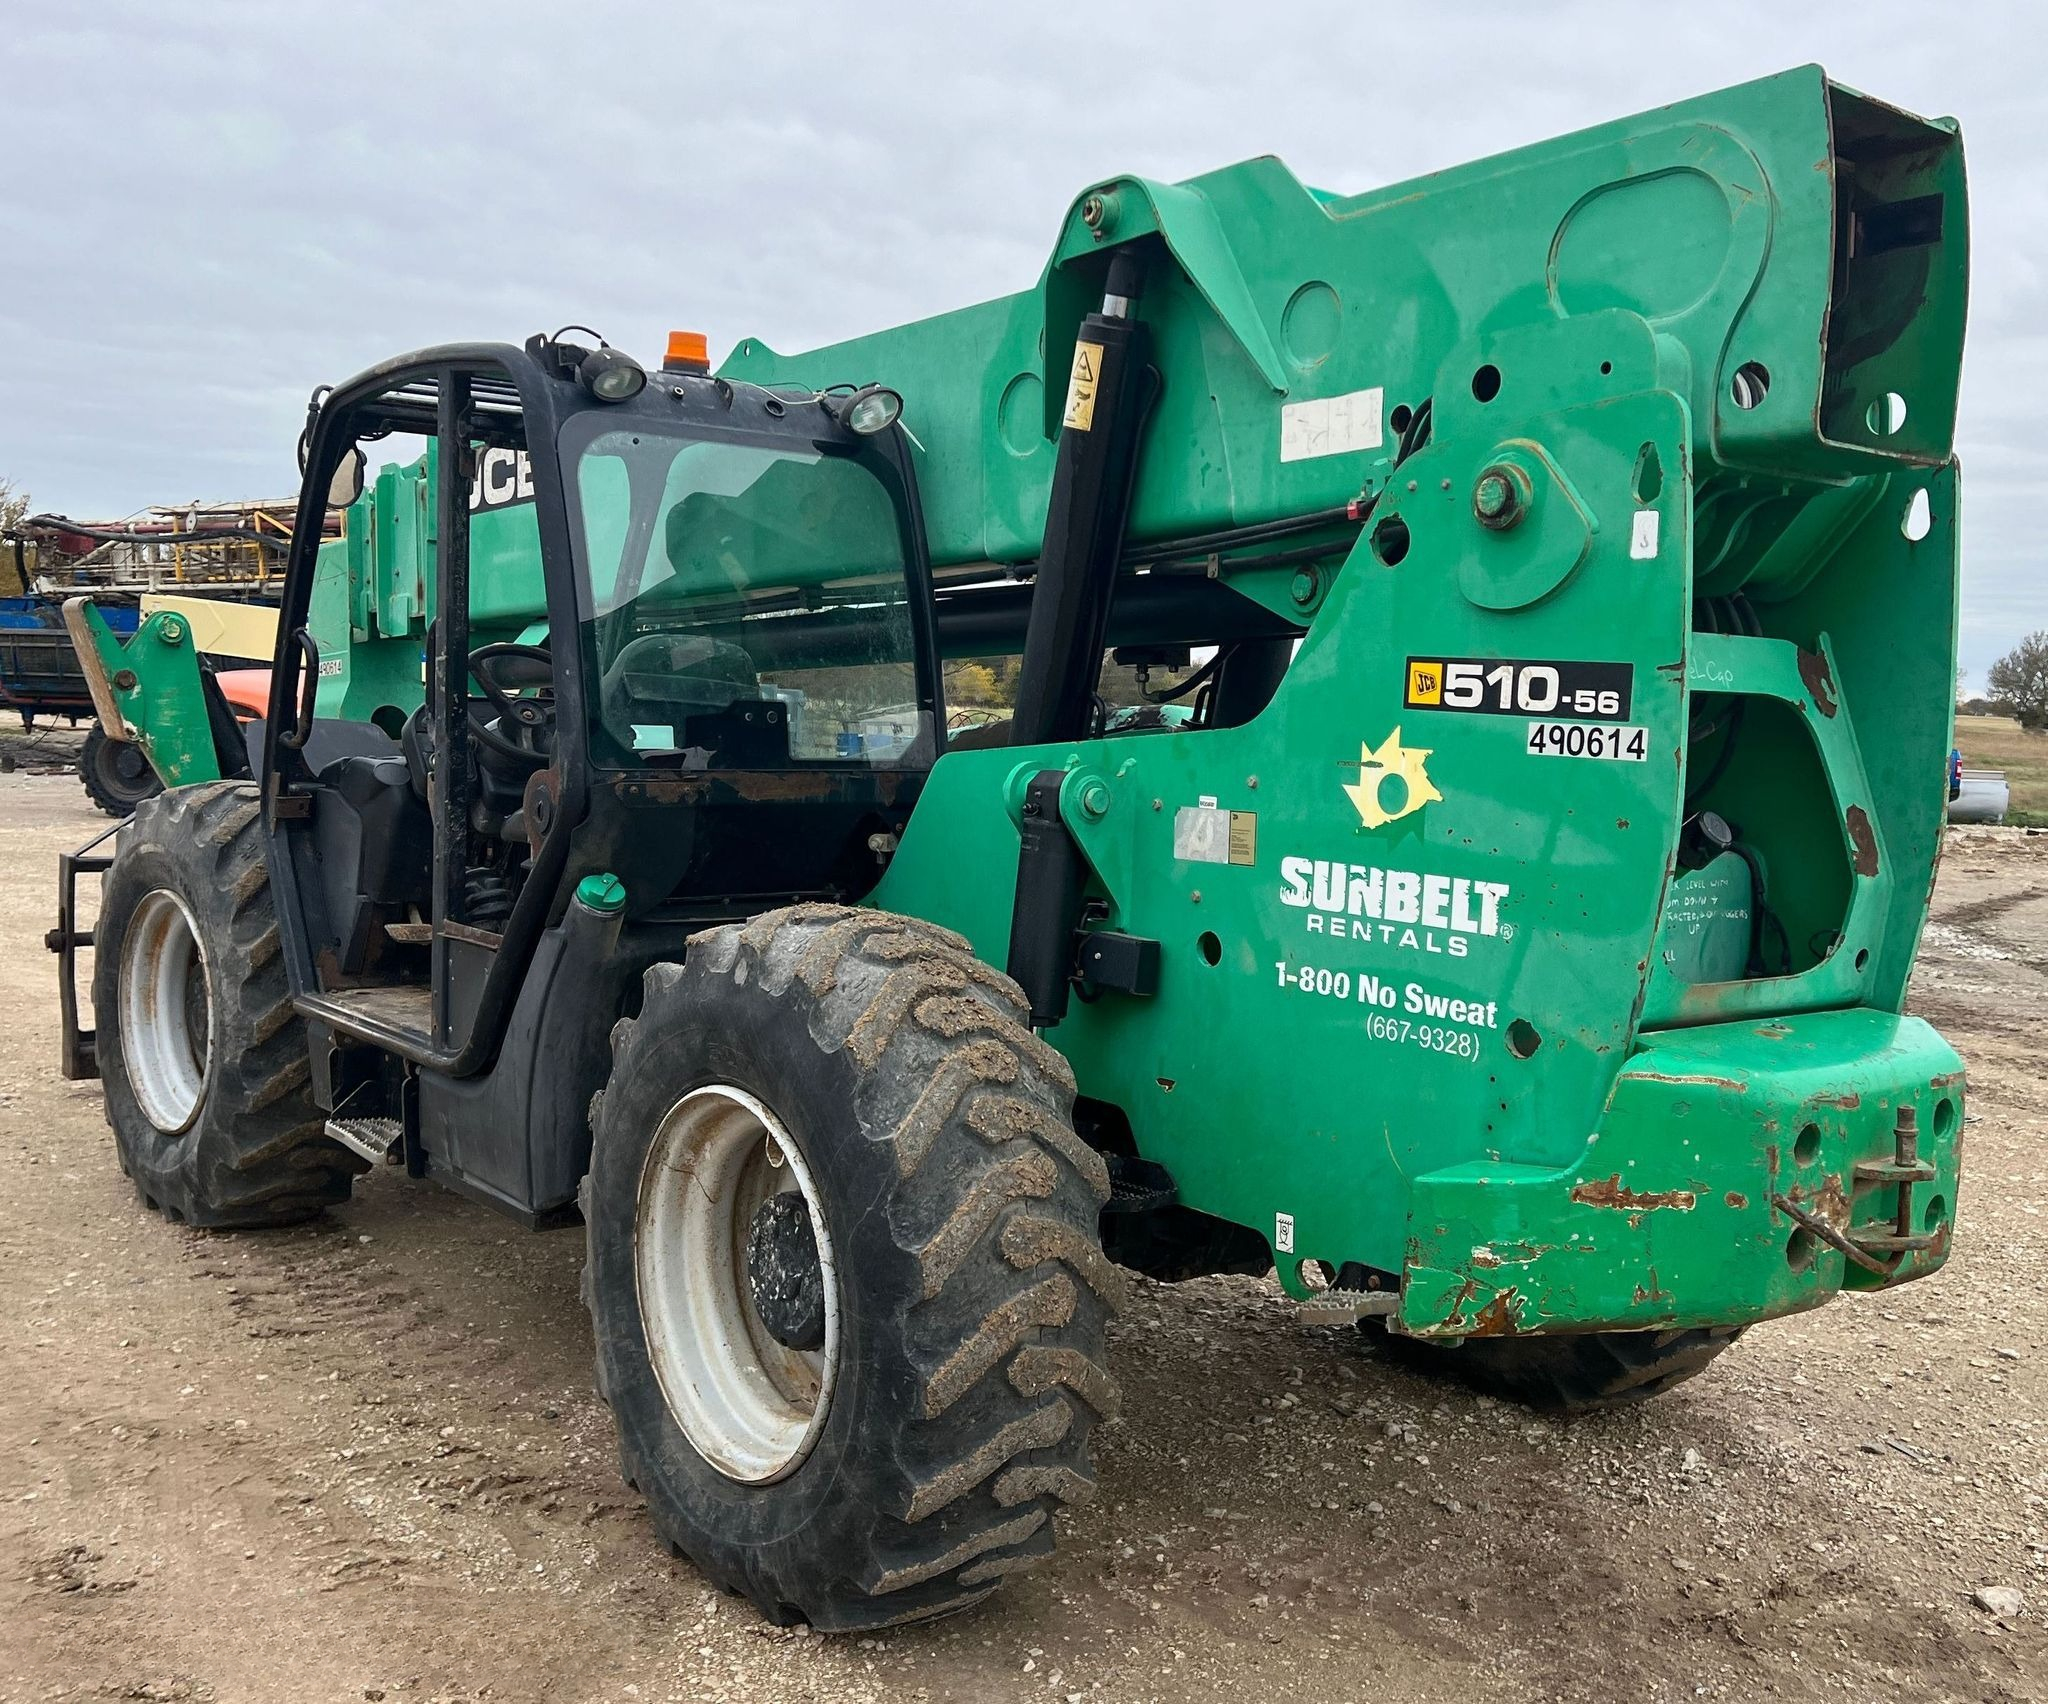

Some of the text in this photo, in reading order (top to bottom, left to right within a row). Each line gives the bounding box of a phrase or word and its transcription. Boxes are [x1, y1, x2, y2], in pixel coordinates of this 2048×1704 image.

[1416, 671, 1437, 694] JCB
[1529, 724, 1646, 760] 490614
[1279, 855, 1510, 937] SUNBELT
[1306, 914, 1469, 957] RENTALS
[1275, 961, 1498, 1029] 1-800 No Sweat
[1366, 1012, 1481, 1063] (667-9328)
